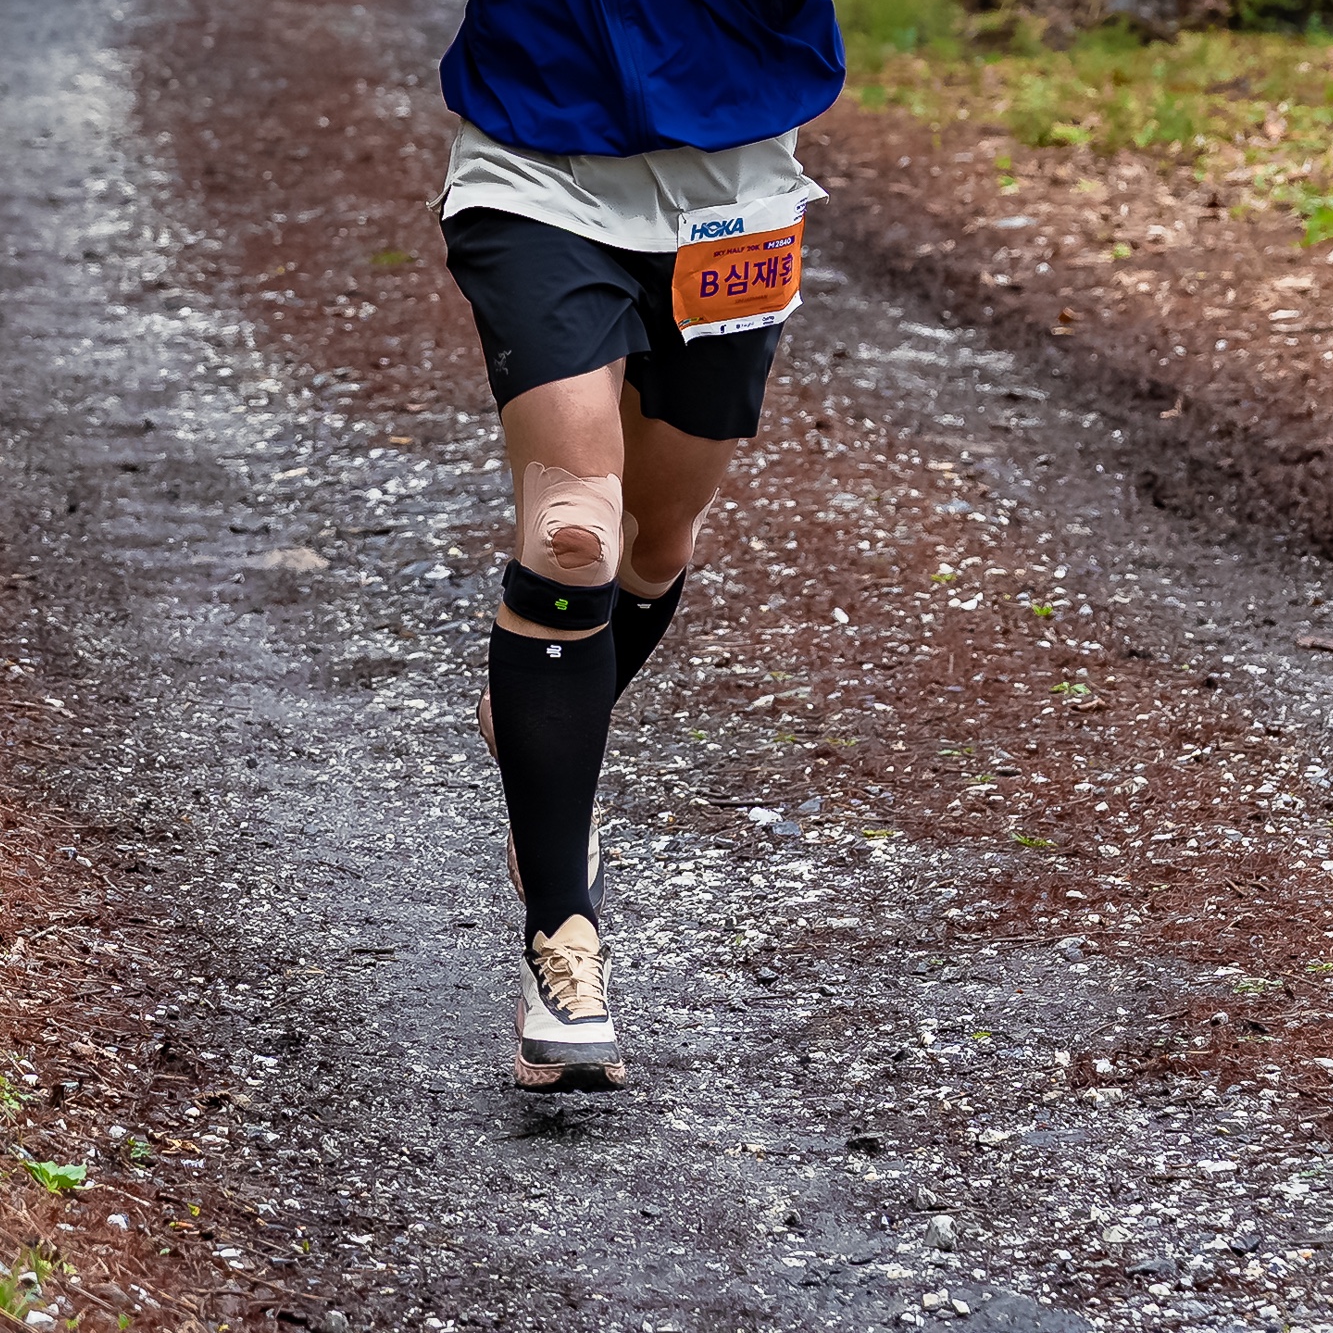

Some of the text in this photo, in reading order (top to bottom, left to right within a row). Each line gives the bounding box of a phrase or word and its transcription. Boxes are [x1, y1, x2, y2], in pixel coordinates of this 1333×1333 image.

[690, 217, 745, 241] HOKA
[747, 243, 761, 252] 20K
[699, 270, 720, 298] B
